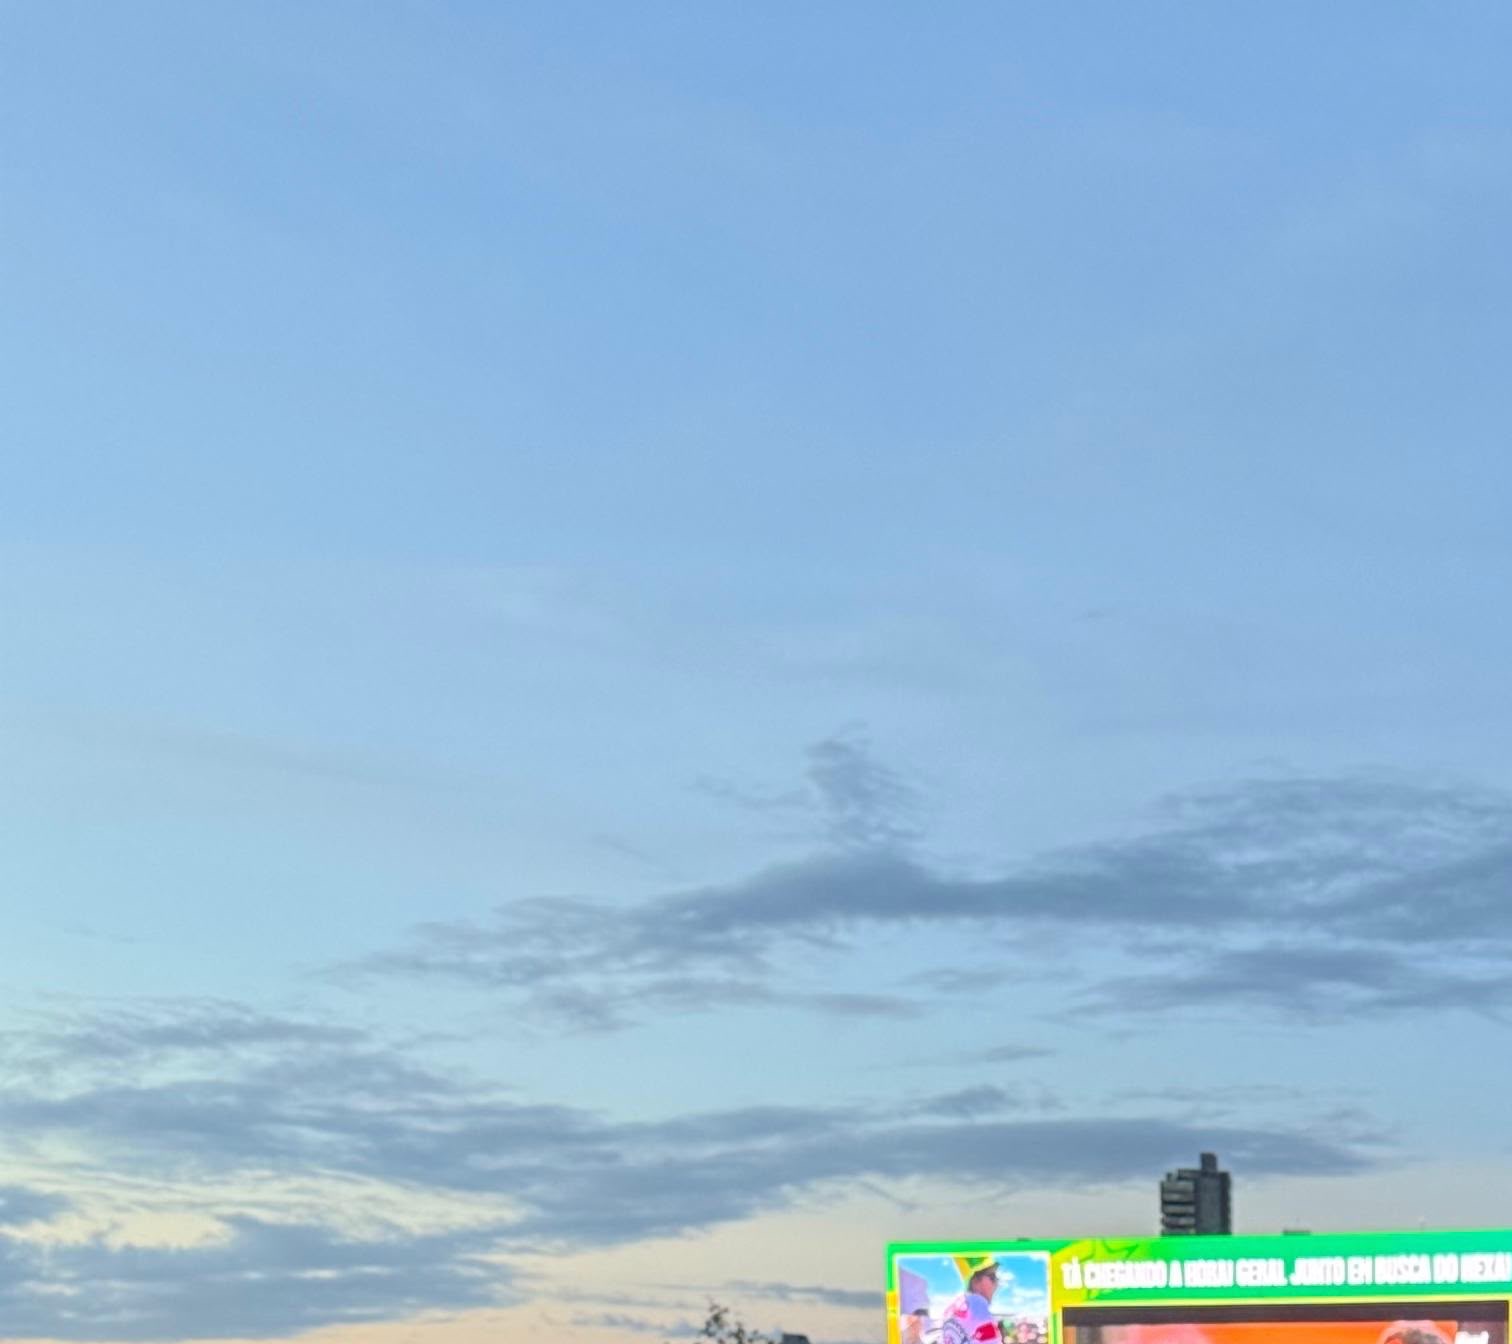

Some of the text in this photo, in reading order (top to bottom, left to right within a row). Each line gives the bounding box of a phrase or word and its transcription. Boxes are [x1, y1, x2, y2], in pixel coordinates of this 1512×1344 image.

[1084, 1259, 1168, 1288] CHEGANDO
[1169, 1259, 1183, 1287] A
[1347, 1255, 1373, 1286] EM
[1374, 1253, 1432, 1285] BUSCA
[1432, 1252, 1459, 1284] DO
